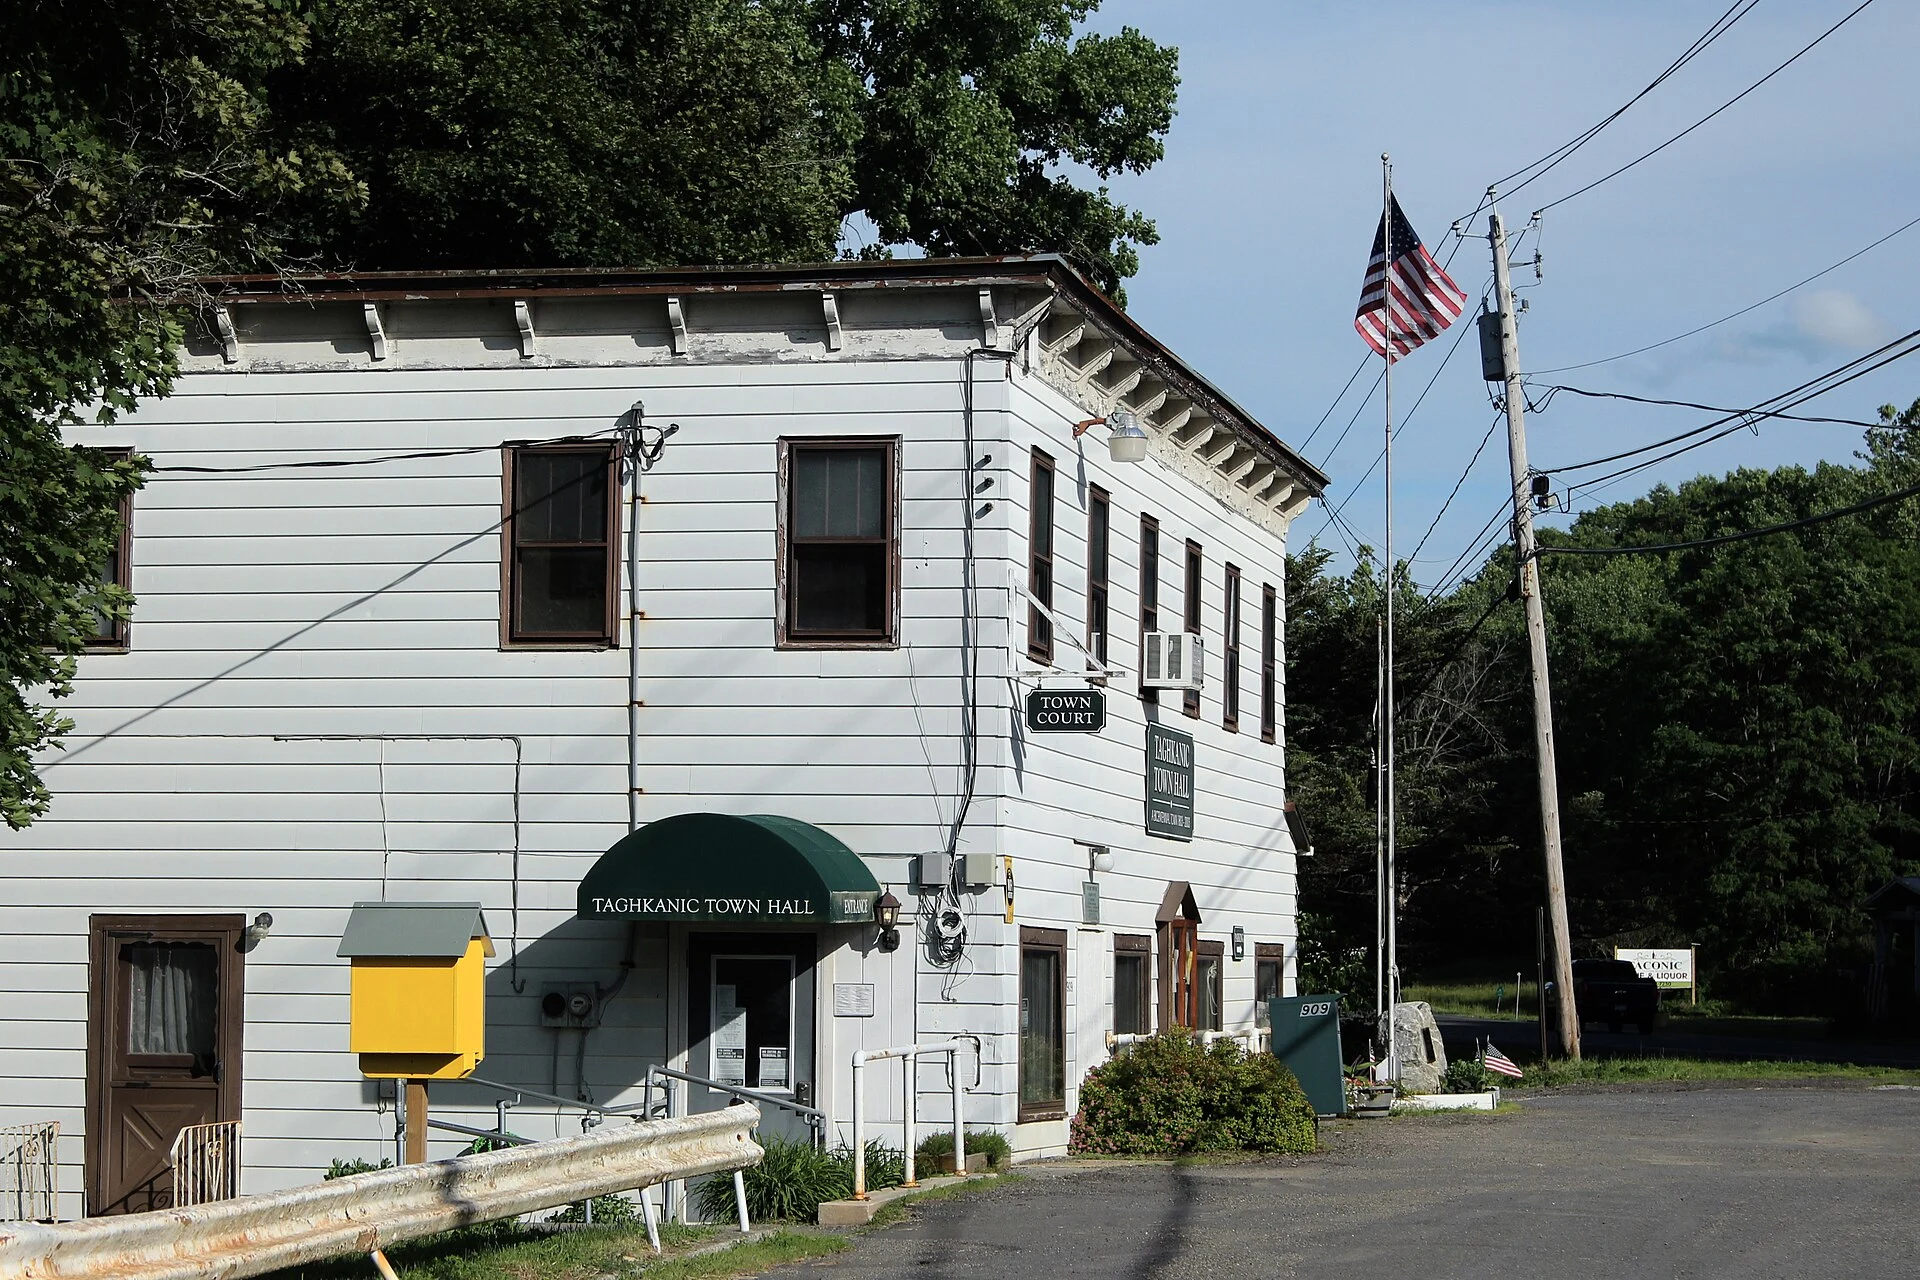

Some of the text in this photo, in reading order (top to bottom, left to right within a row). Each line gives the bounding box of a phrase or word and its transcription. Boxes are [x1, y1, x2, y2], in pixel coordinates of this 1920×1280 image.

[1040, 696, 1091, 709] TOWN
[1036, 711, 1095, 724] COURT
[1154, 734, 1190, 768] TAGHKANIC
[1153, 766, 1190, 799] TOWN HALL
[591, 897, 815, 915] TAGHKANIC TOWN HALL
[844, 898, 869, 914] ENTRANCE
[1656, 972, 1688, 980] LIQUOR
[1301, 1004, 1329, 1016] 909
